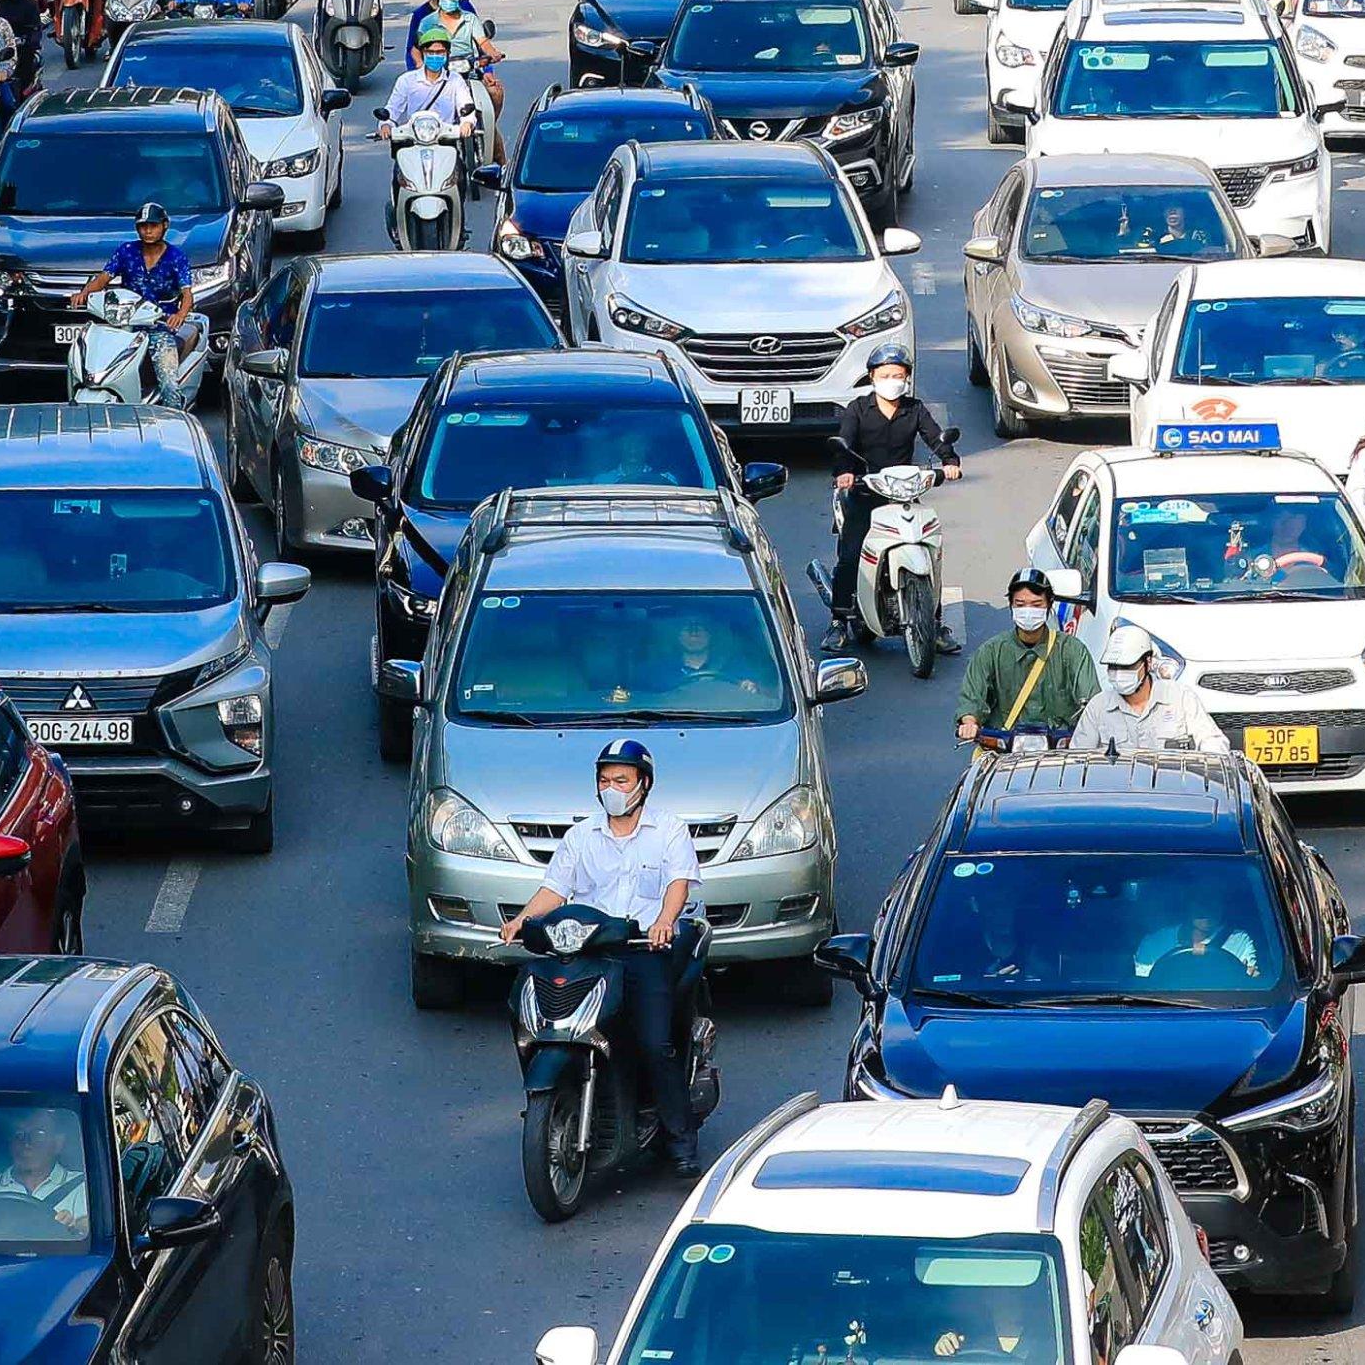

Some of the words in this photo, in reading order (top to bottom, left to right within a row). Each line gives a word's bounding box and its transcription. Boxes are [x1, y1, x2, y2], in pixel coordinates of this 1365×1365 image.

[753, 390, 778, 405] 30F
[743, 406, 788, 422] 707.60
[1188, 430, 1223, 444] SAO
[1228, 430, 1260, 444] MAI
[29, 722, 130, 741] 30G-244.98
[1266, 729, 1296, 744] 30F
[1253, 746, 1309, 762] 757.85
